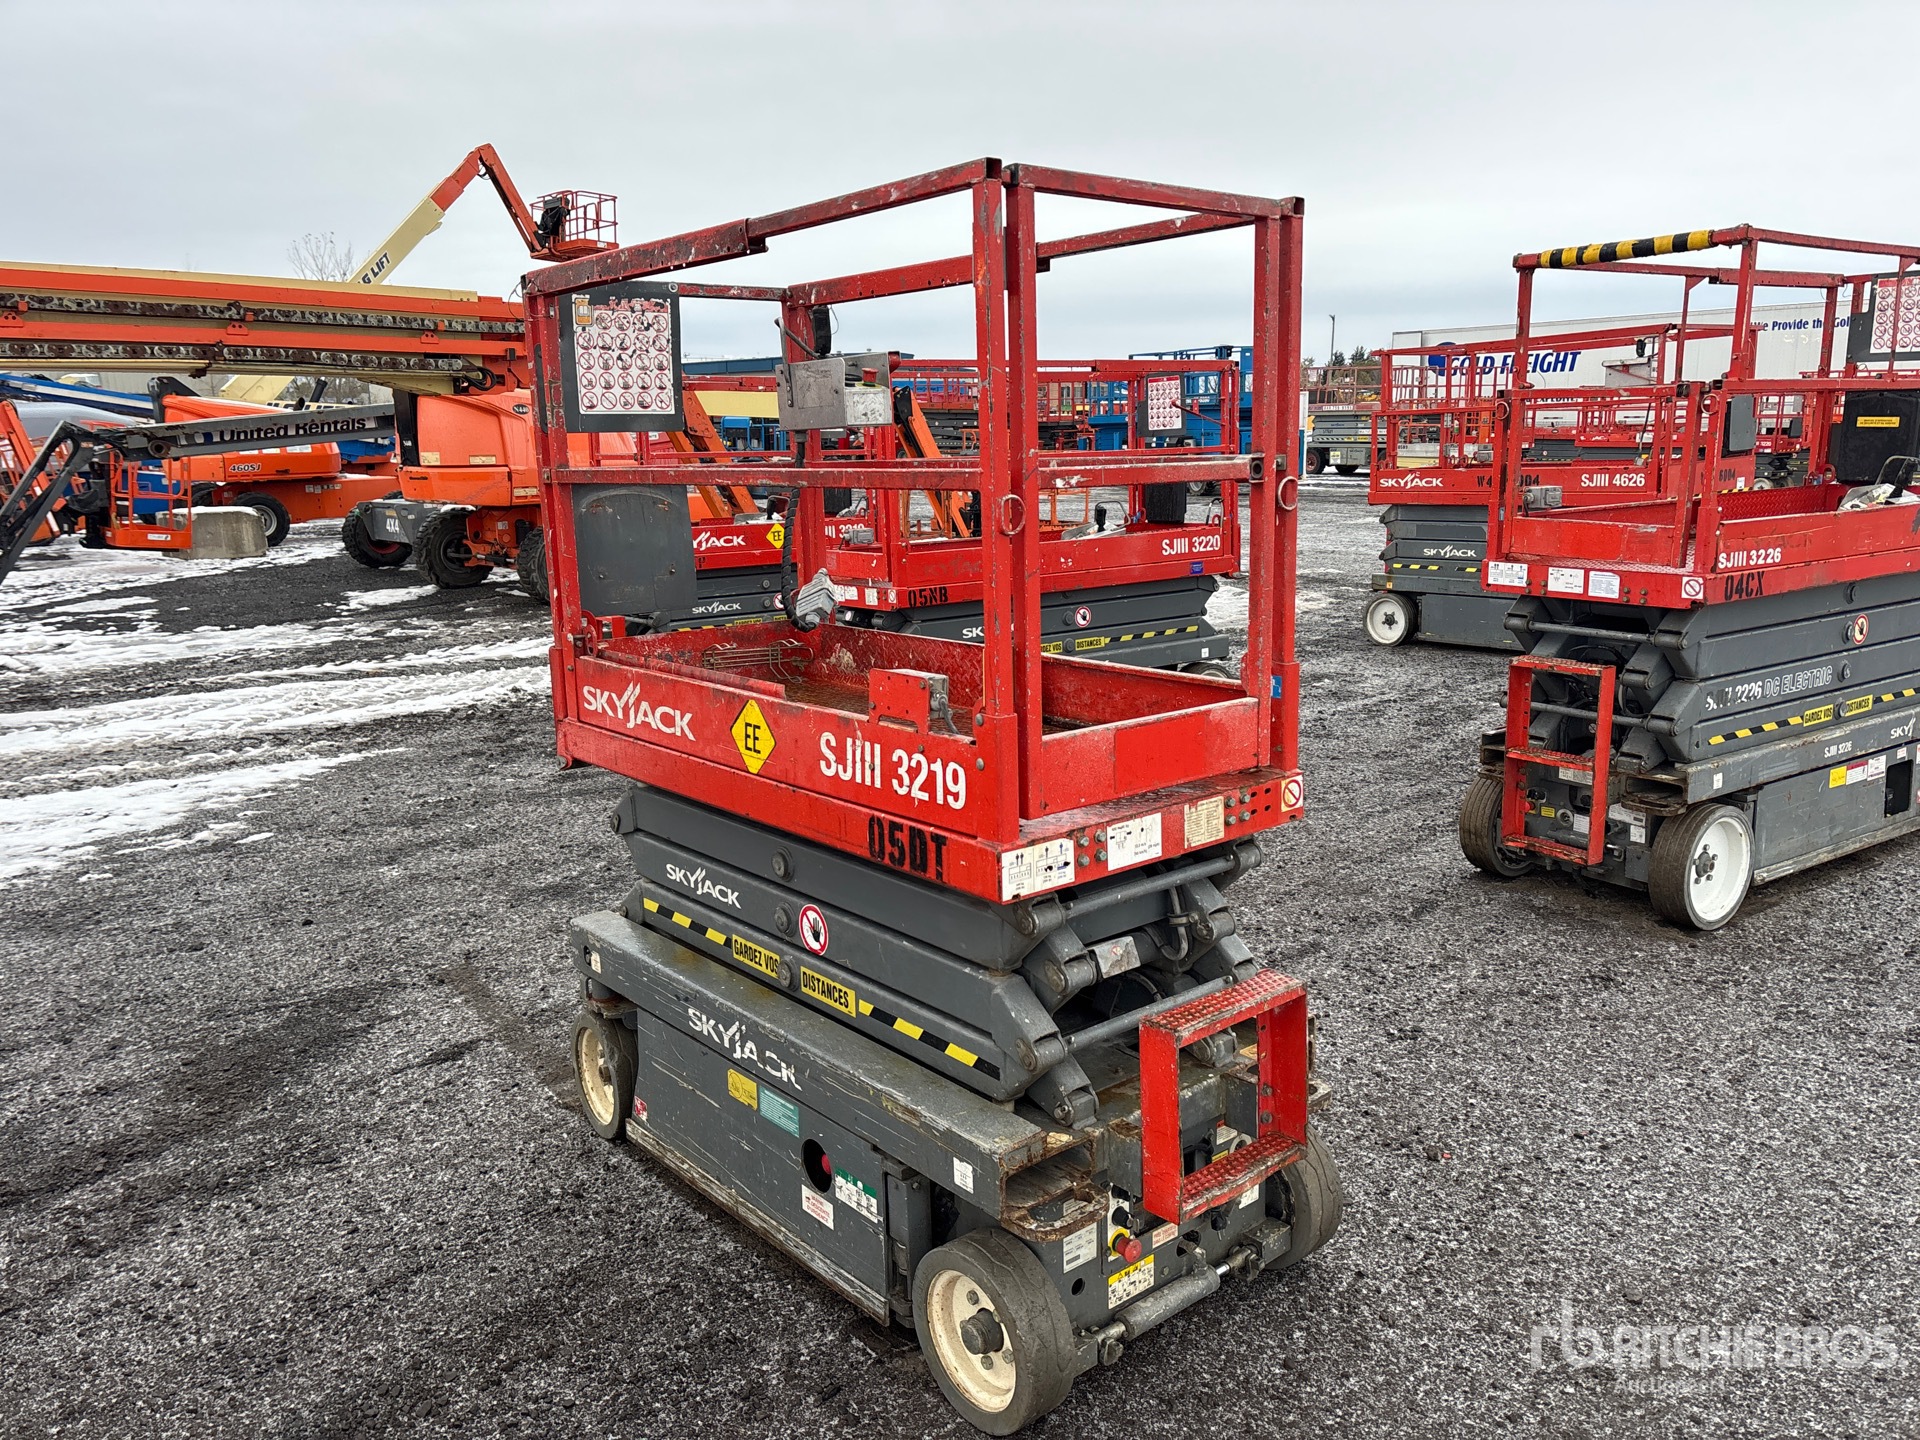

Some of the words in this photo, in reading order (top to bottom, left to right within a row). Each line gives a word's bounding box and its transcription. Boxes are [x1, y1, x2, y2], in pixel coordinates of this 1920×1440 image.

[370, 252, 391, 278] LIFT
[1771, 318, 1809, 331] Provide
[1812, 318, 1824, 329] th
[1834, 317, 1850, 328] Gol
[220, 424, 289, 442] United
[295, 417, 366, 436] Rentals
[229, 462, 262, 472] 460SJ
[1379, 473, 1444, 489] SKYJACK
[1581, 474, 1610, 488] SJIII
[1612, 473, 1646, 488] 4626
[386, 518, 399, 533] 4X4
[771, 530, 783, 542] EE
[1161, 537, 1189, 556] SJIII
[1191, 534, 1221, 553] 3220
[1423, 544, 1477, 559] SKYJACK
[1717, 550, 1747, 570] SJIII
[1749, 547, 1782, 566] 3226
[907, 586, 949, 608] 05NB
[1724, 571, 1766, 602] 04CX
[691, 601, 742, 614] SKYJACK
[1052, 642, 1062, 652] VOS
[1076, 638, 1103, 649] DISTANCES
[1763, 678, 1780, 699] DC
[1781, 665, 1833, 695] ELECTRIC
[582, 680, 696, 742] SKYJACK
[1804, 709, 1823, 725] GARDEZ
[1823, 706, 1834, 719] VOS
[743, 721, 762, 755] EE
[819, 731, 881, 790] SJIII
[891, 748, 967, 810] 3219
[867, 815, 949, 883] 05DT
[666, 862, 742, 910] SKYJACK
[733, 938, 762, 967] GARDEZ
[763, 951, 779, 975] VOS
[801, 970, 850, 1010] DISTANCES
[688, 1007, 803, 1092] SKYJACK
